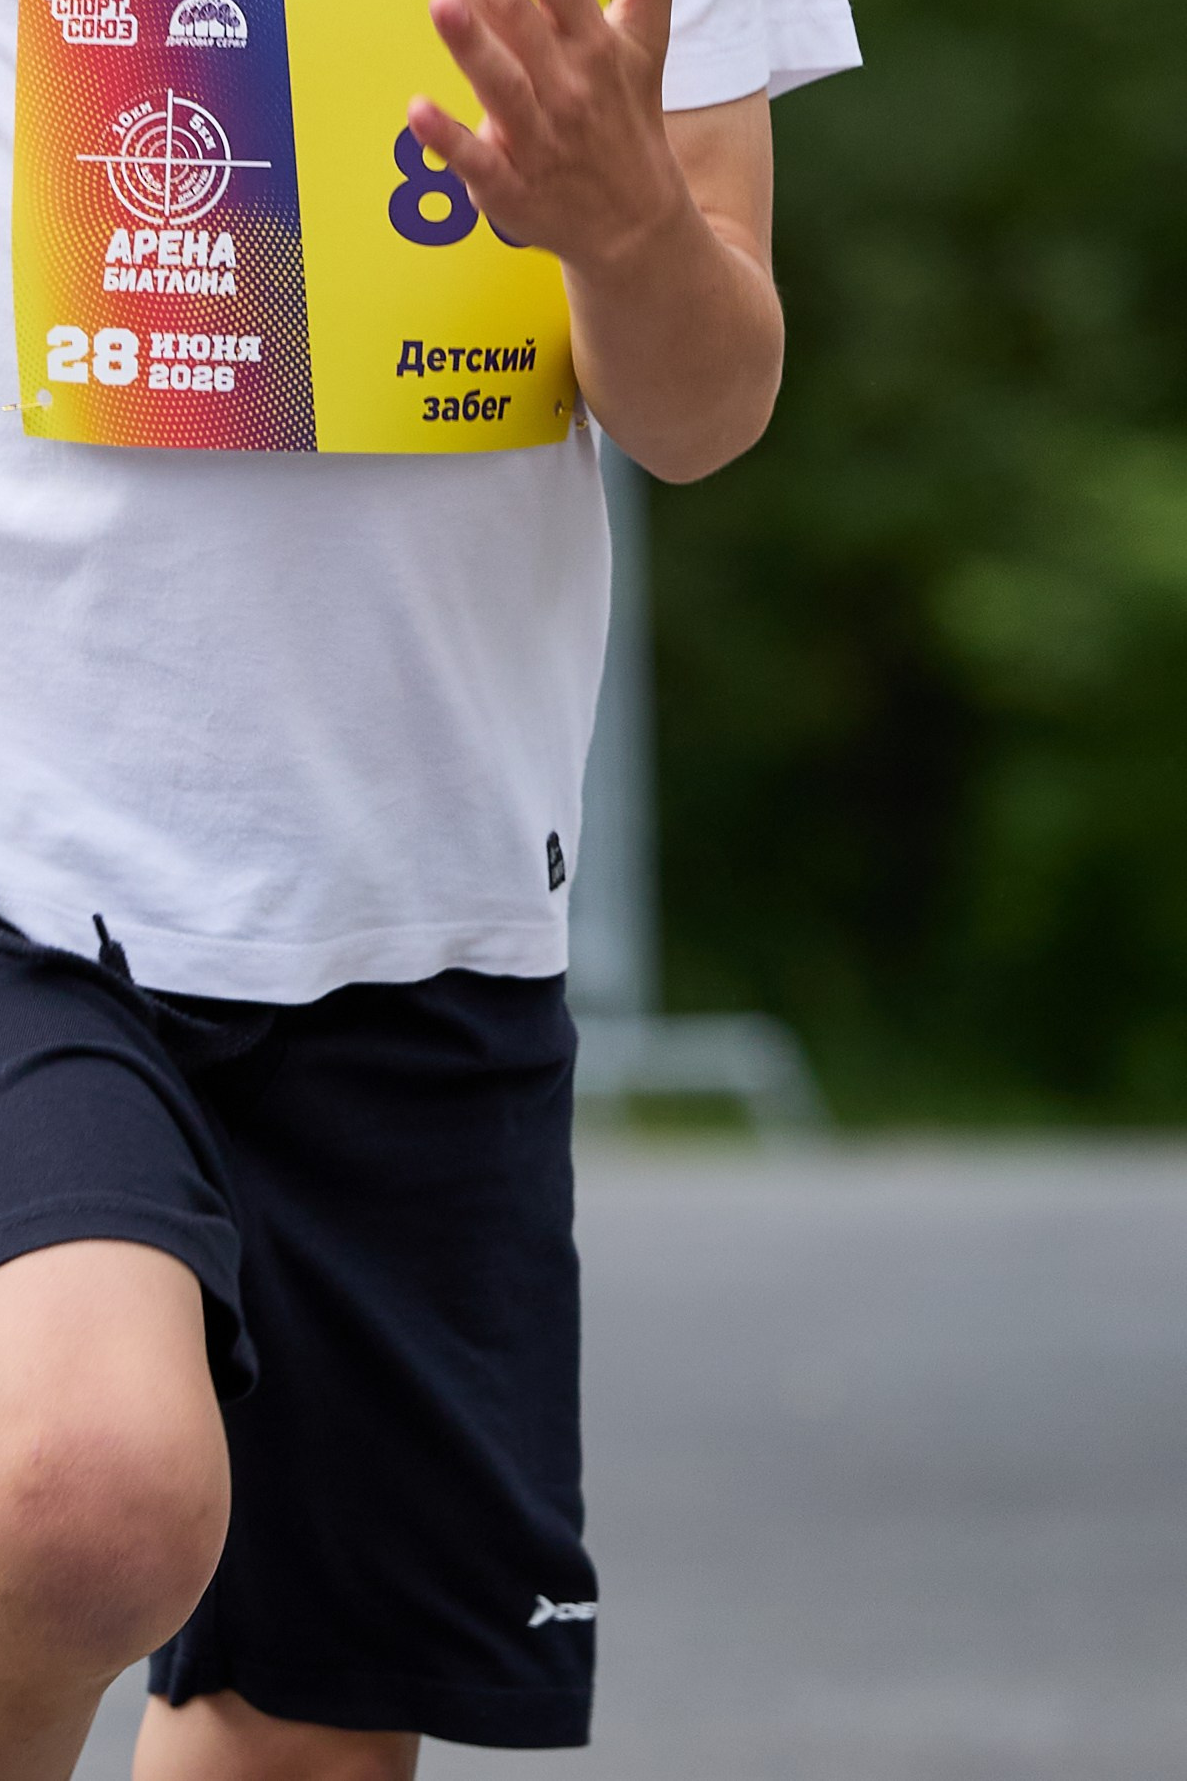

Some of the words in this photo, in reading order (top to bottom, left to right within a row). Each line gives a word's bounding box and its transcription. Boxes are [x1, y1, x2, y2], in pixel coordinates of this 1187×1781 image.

[68, 18, 133, 40] СОЮЗ
[387, 120, 535, 249] 8
[104, 227, 237, 269] АРЕНА
[102, 265, 237, 296] БИАТЛОНА
[46, 324, 139, 387] 28
[149, 331, 262, 363] ИЮНЯ
[396, 338, 537, 378] Детский
[148, 363, 235, 393] 2026
[422, 389, 511, 422] забег
